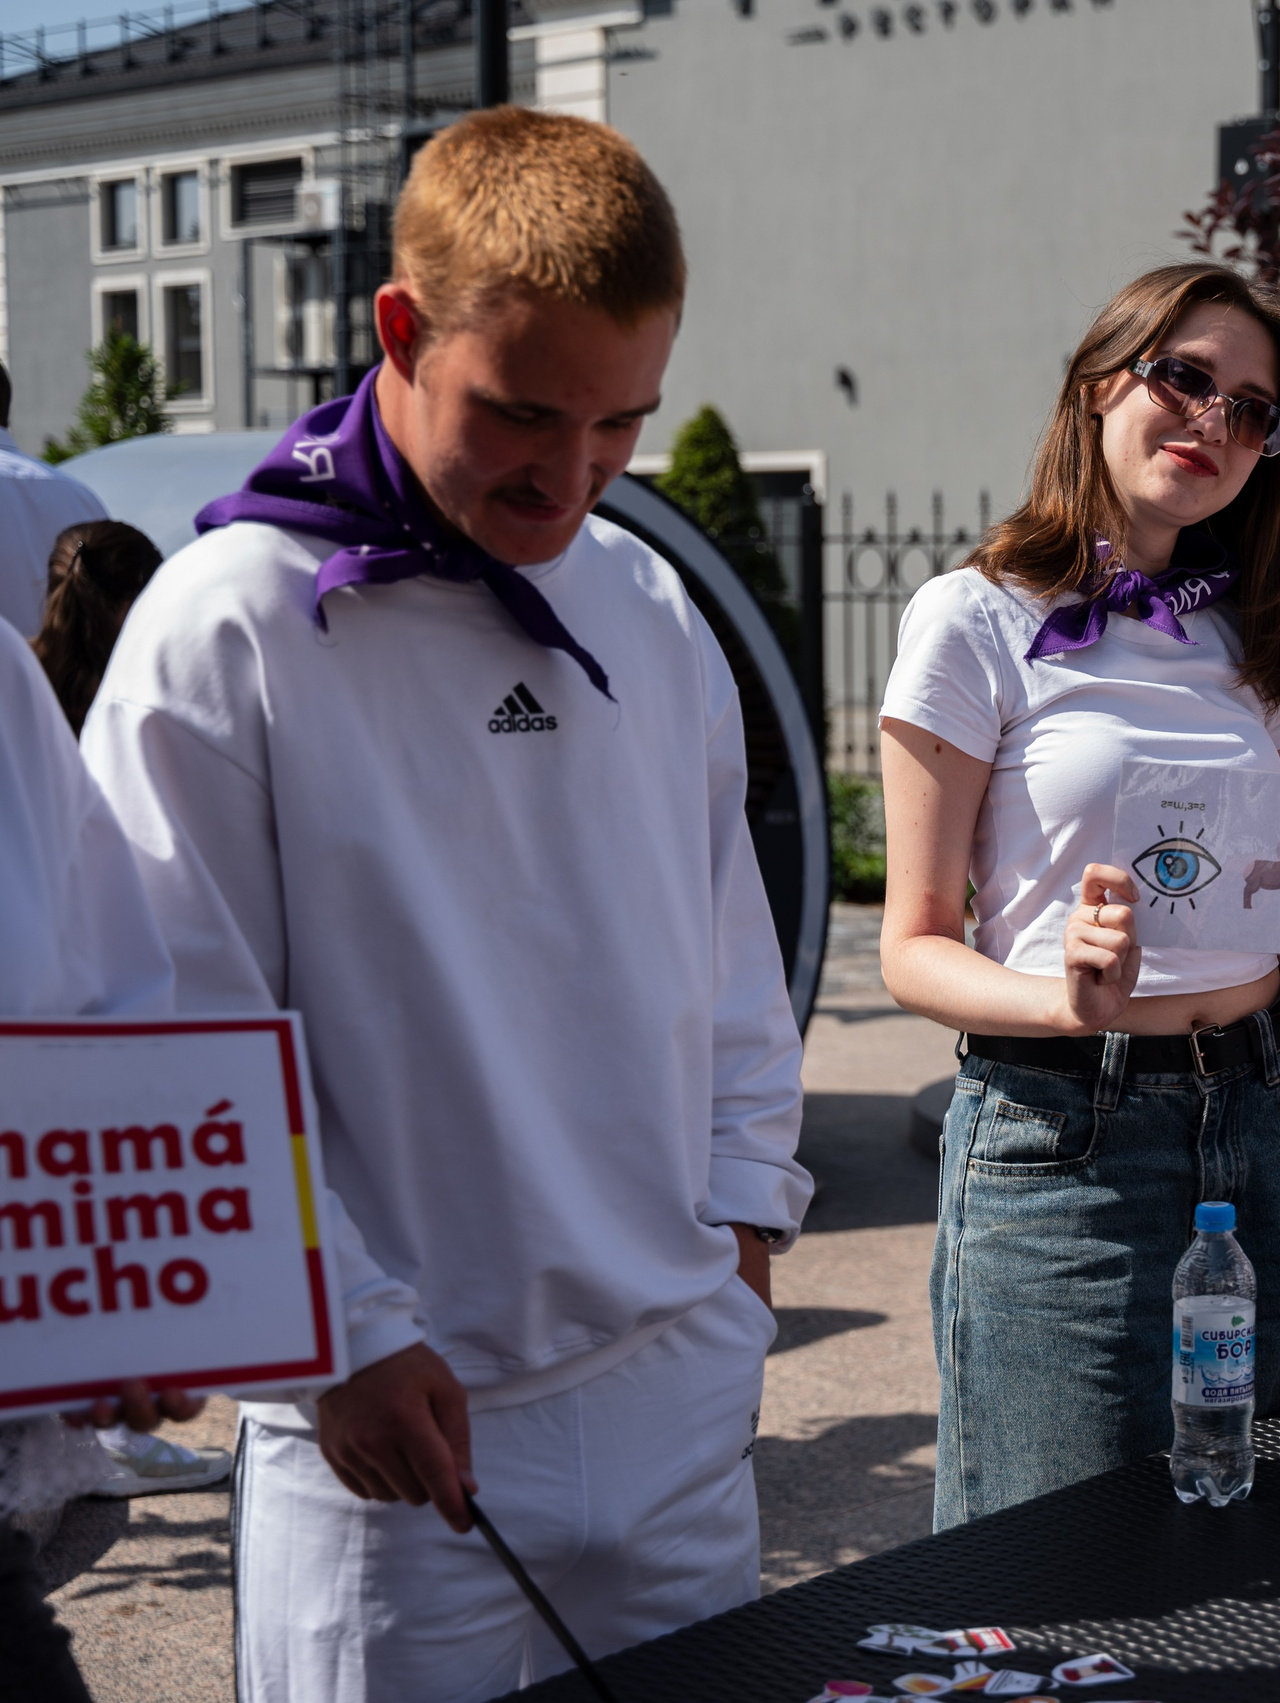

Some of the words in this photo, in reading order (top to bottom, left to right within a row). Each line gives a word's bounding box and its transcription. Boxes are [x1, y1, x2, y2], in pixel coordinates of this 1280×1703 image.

[488, 714, 558, 734] adidas
[1202, 1327, 1256, 1340] СИБИРСКИ
[1216, 1340, 1251, 1359] БОР
[1204, 1388, 1228, 1397] ВОДА
